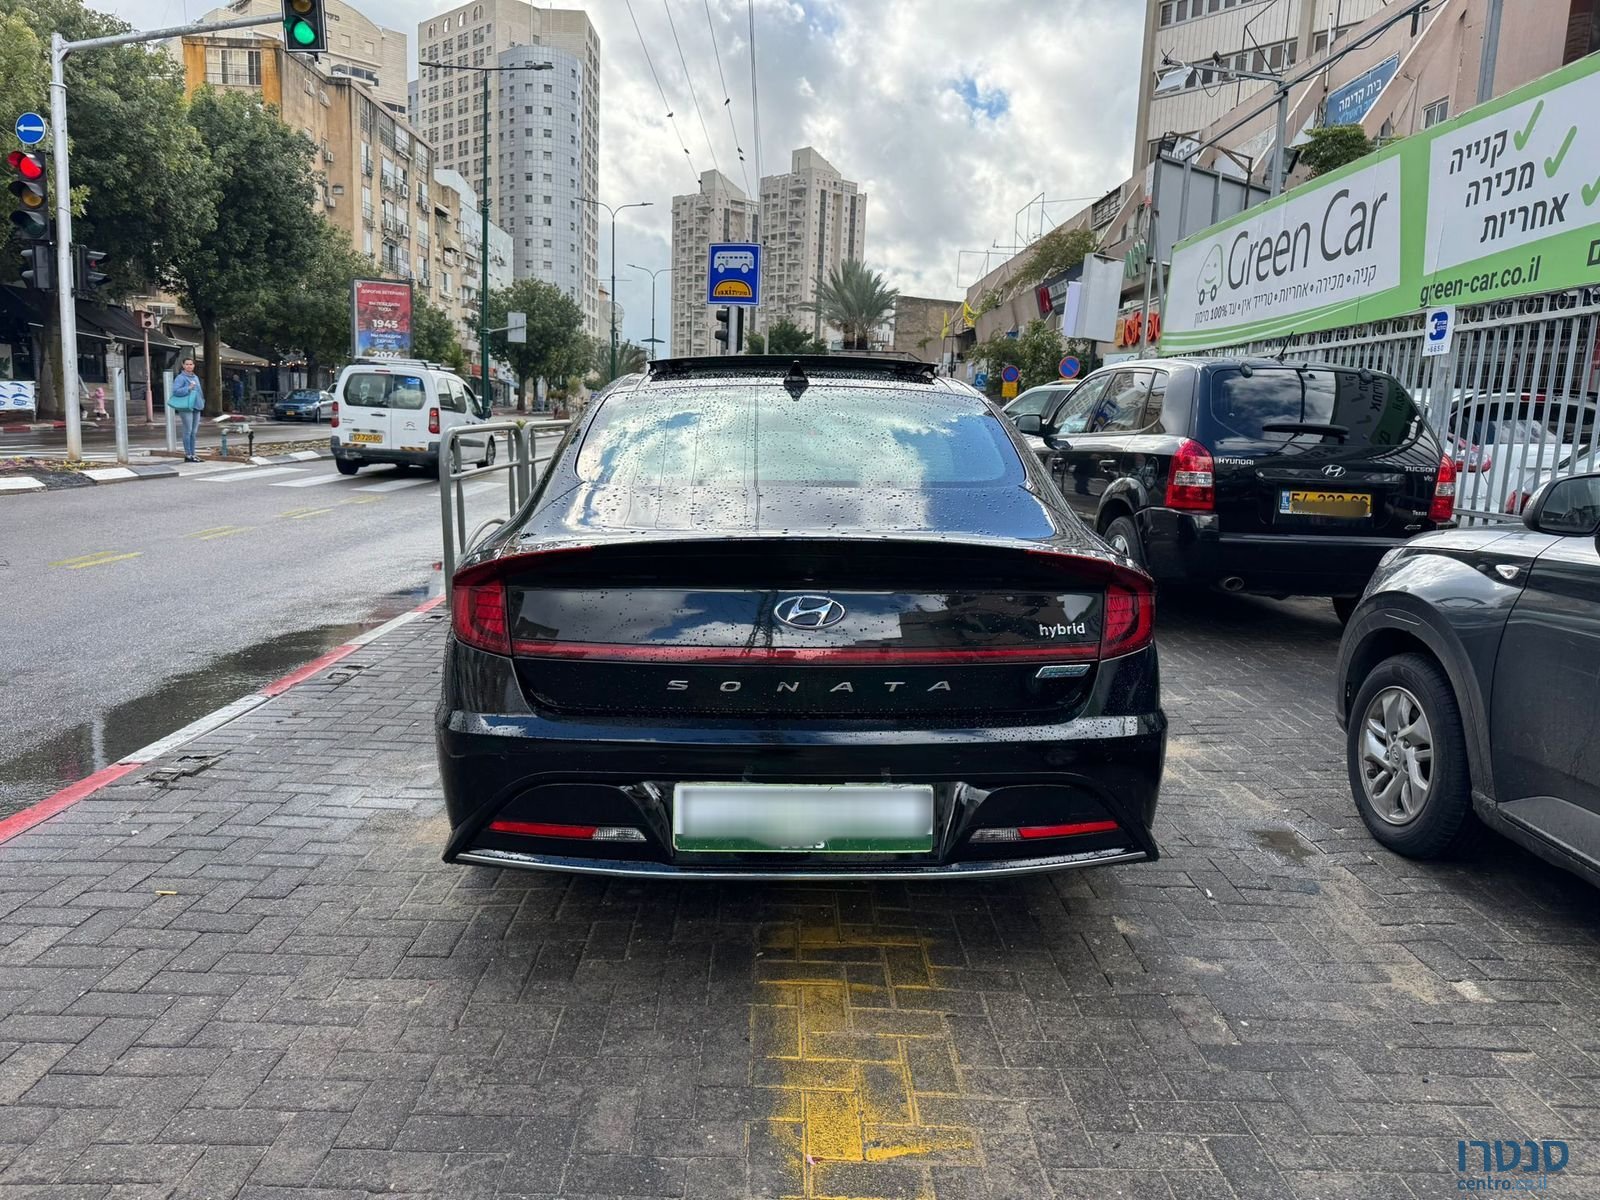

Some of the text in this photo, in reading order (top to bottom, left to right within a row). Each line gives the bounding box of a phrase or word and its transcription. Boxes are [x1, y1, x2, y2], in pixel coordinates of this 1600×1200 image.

[1367, 79, 1381, 96] בית
[1339, 88, 1364, 112] קדימה
[1449, 129, 1508, 175] קנייה
[1465, 161, 1535, 208] מכירה
[1480, 193, 1570, 243] אחריות
[1227, 222, 1311, 290] Green
[1320, 189, 1388, 262] Car
[1315, 273, 1344, 293] מכירה
[1352, 264, 1377, 287] קניה
[1419, 255, 1542, 308] green-car.co.il
[1279, 282, 1308, 303] אחריות
[1210, 305, 1228, 320] 100%
[372, 319, 398, 329] 1945
[1038, 622, 1086, 638] hybrid
[666, 680, 952, 693] SONATA
